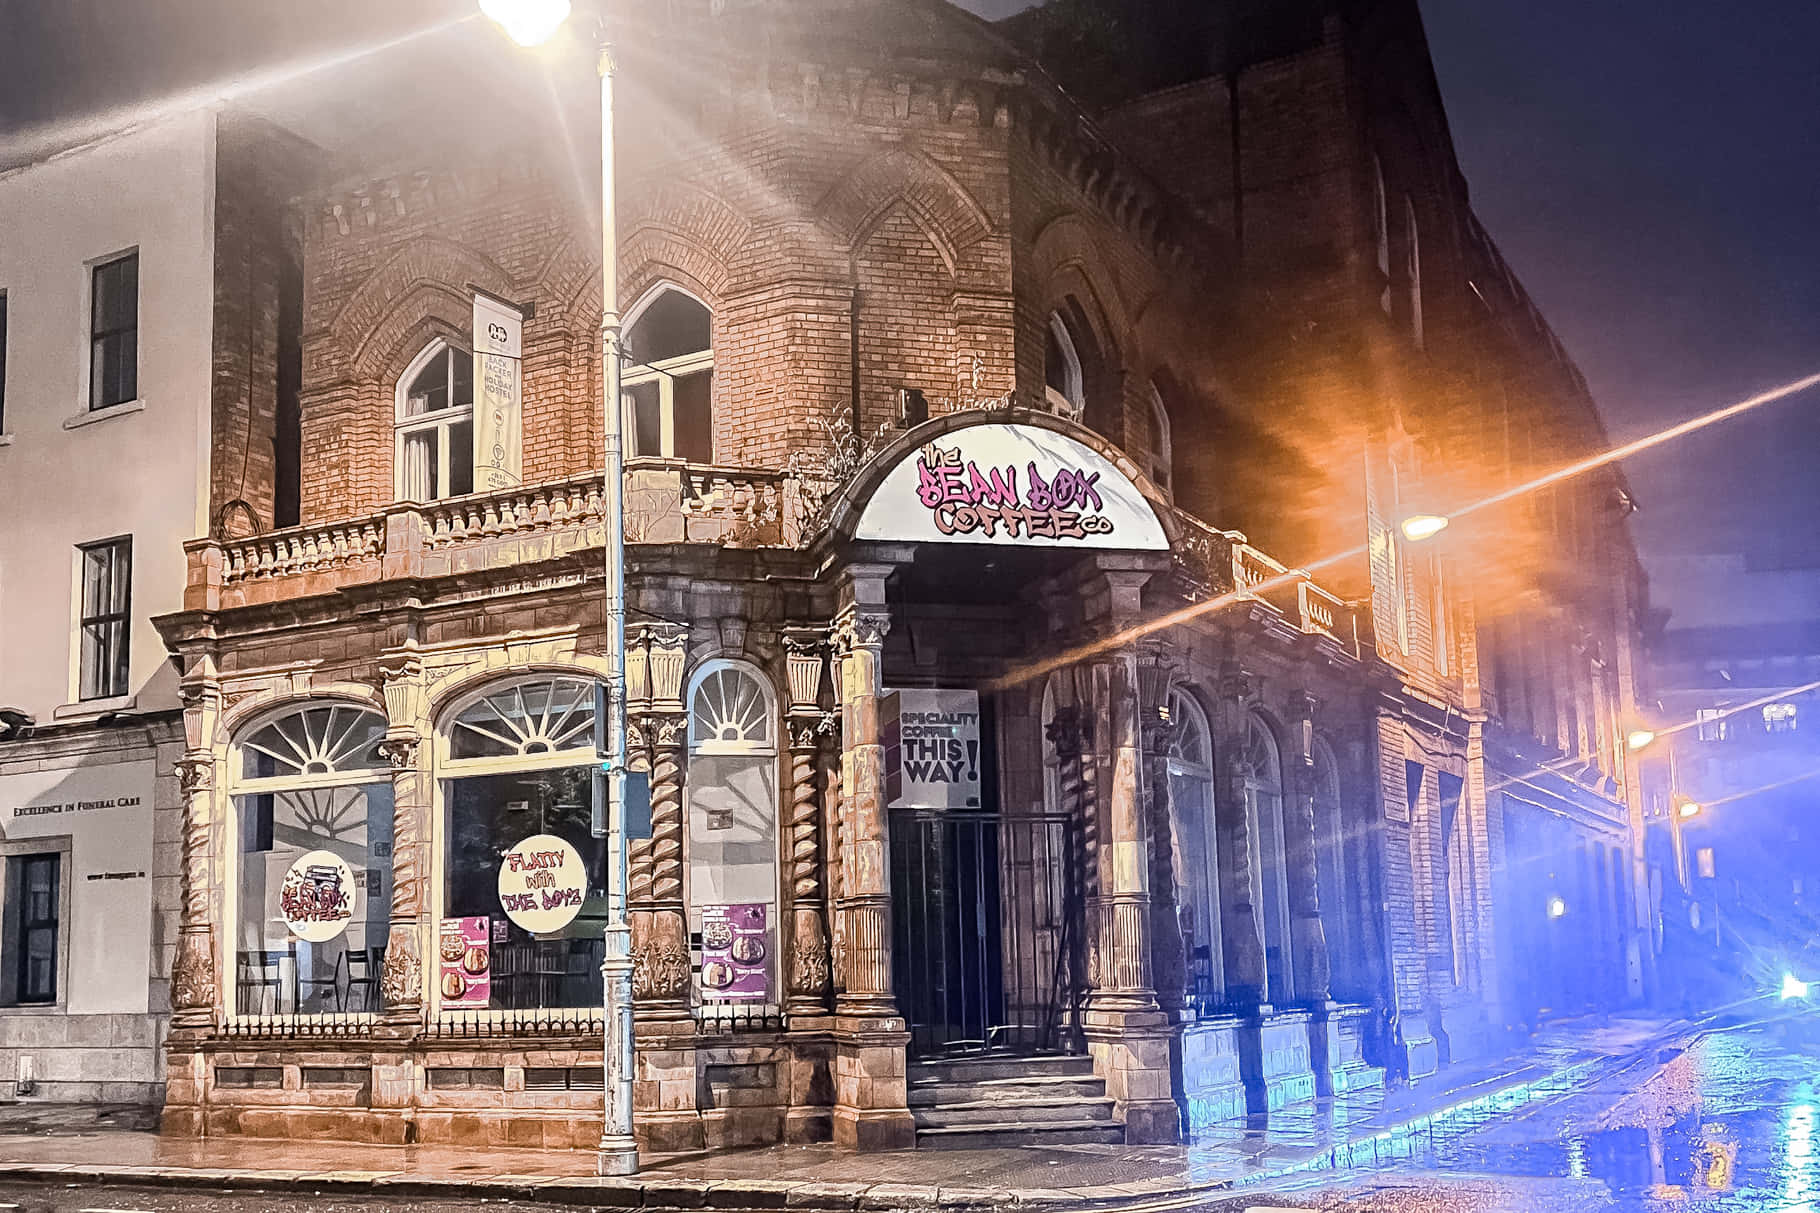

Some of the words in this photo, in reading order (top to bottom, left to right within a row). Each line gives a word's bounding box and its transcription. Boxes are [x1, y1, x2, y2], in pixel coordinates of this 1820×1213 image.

[916, 457, 1020, 509] BEAN
[1026, 461, 1103, 512] BOX
[934, 502, 1087, 540] COFFEE
[901, 712, 978, 725] SPECIALITY
[902, 739, 962, 761] THIS
[506, 849, 565, 872] FLATTY
[525, 870, 556, 889] with
[502, 893, 538, 912] THE
